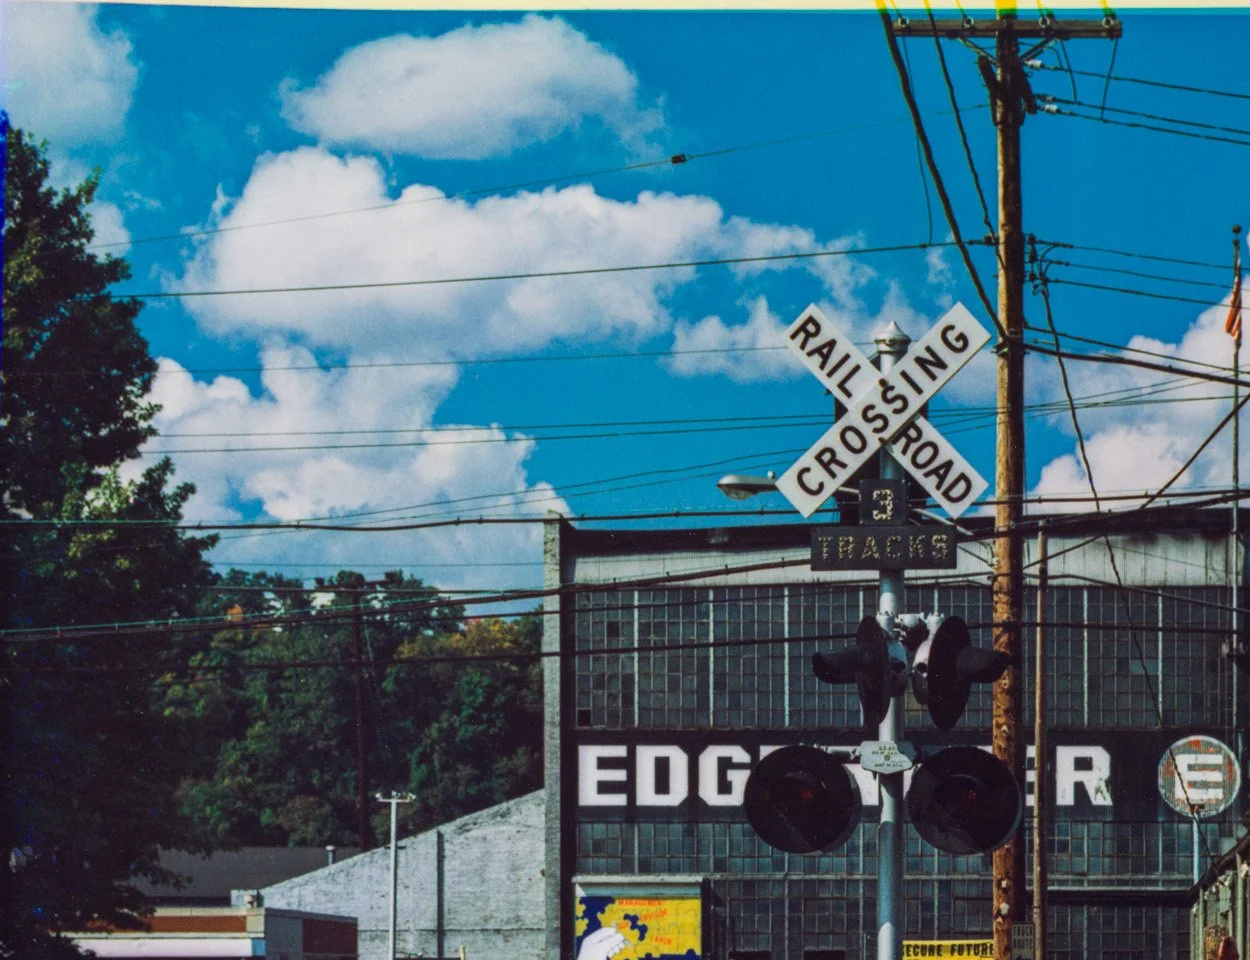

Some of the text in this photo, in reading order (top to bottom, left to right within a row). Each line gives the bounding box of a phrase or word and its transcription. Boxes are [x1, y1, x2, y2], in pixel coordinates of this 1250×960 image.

[789, 315, 972, 504] RAIL ROAD
[796, 324, 970, 496] CROSSING
[872, 489, 894, 520] 3
[818, 534, 948, 560] TRACKS
[1175, 753, 1223, 803] E
